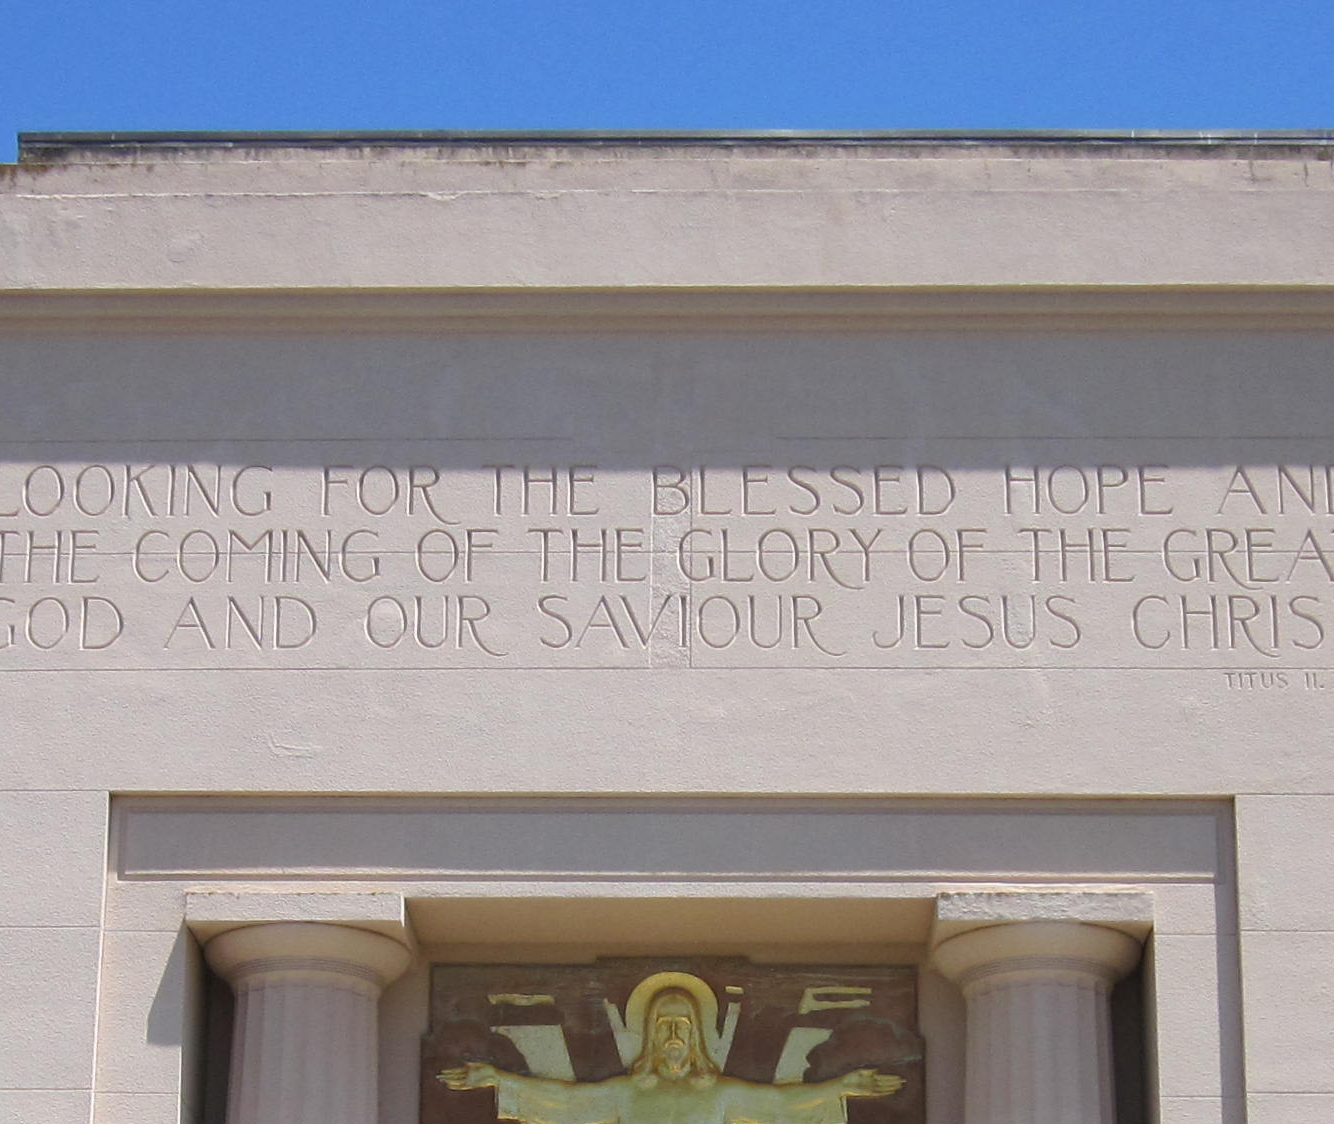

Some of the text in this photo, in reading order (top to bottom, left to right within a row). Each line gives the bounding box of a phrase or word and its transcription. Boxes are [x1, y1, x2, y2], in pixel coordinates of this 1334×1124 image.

[319, 464, 460, 525] FOR
[482, 465, 600, 517] THE
[650, 464, 956, 517] BLESSED
[1002, 464, 1174, 517] HOPE
[131, 528, 382, 584] COMING
[414, 528, 499, 583] OF
[526, 528, 648, 583] THE
[678, 528, 884, 590] GLORY
[906, 528, 990, 582] OF
[1018, 528, 1137, 582] THE
[162, 595, 318, 651] AND
[364, 595, 509, 657] OUR
[538, 595, 848, 656] SAVIOUR
[871, 594, 1083, 650] JESUS
[1223, 671, 1289, 690] TITUS
